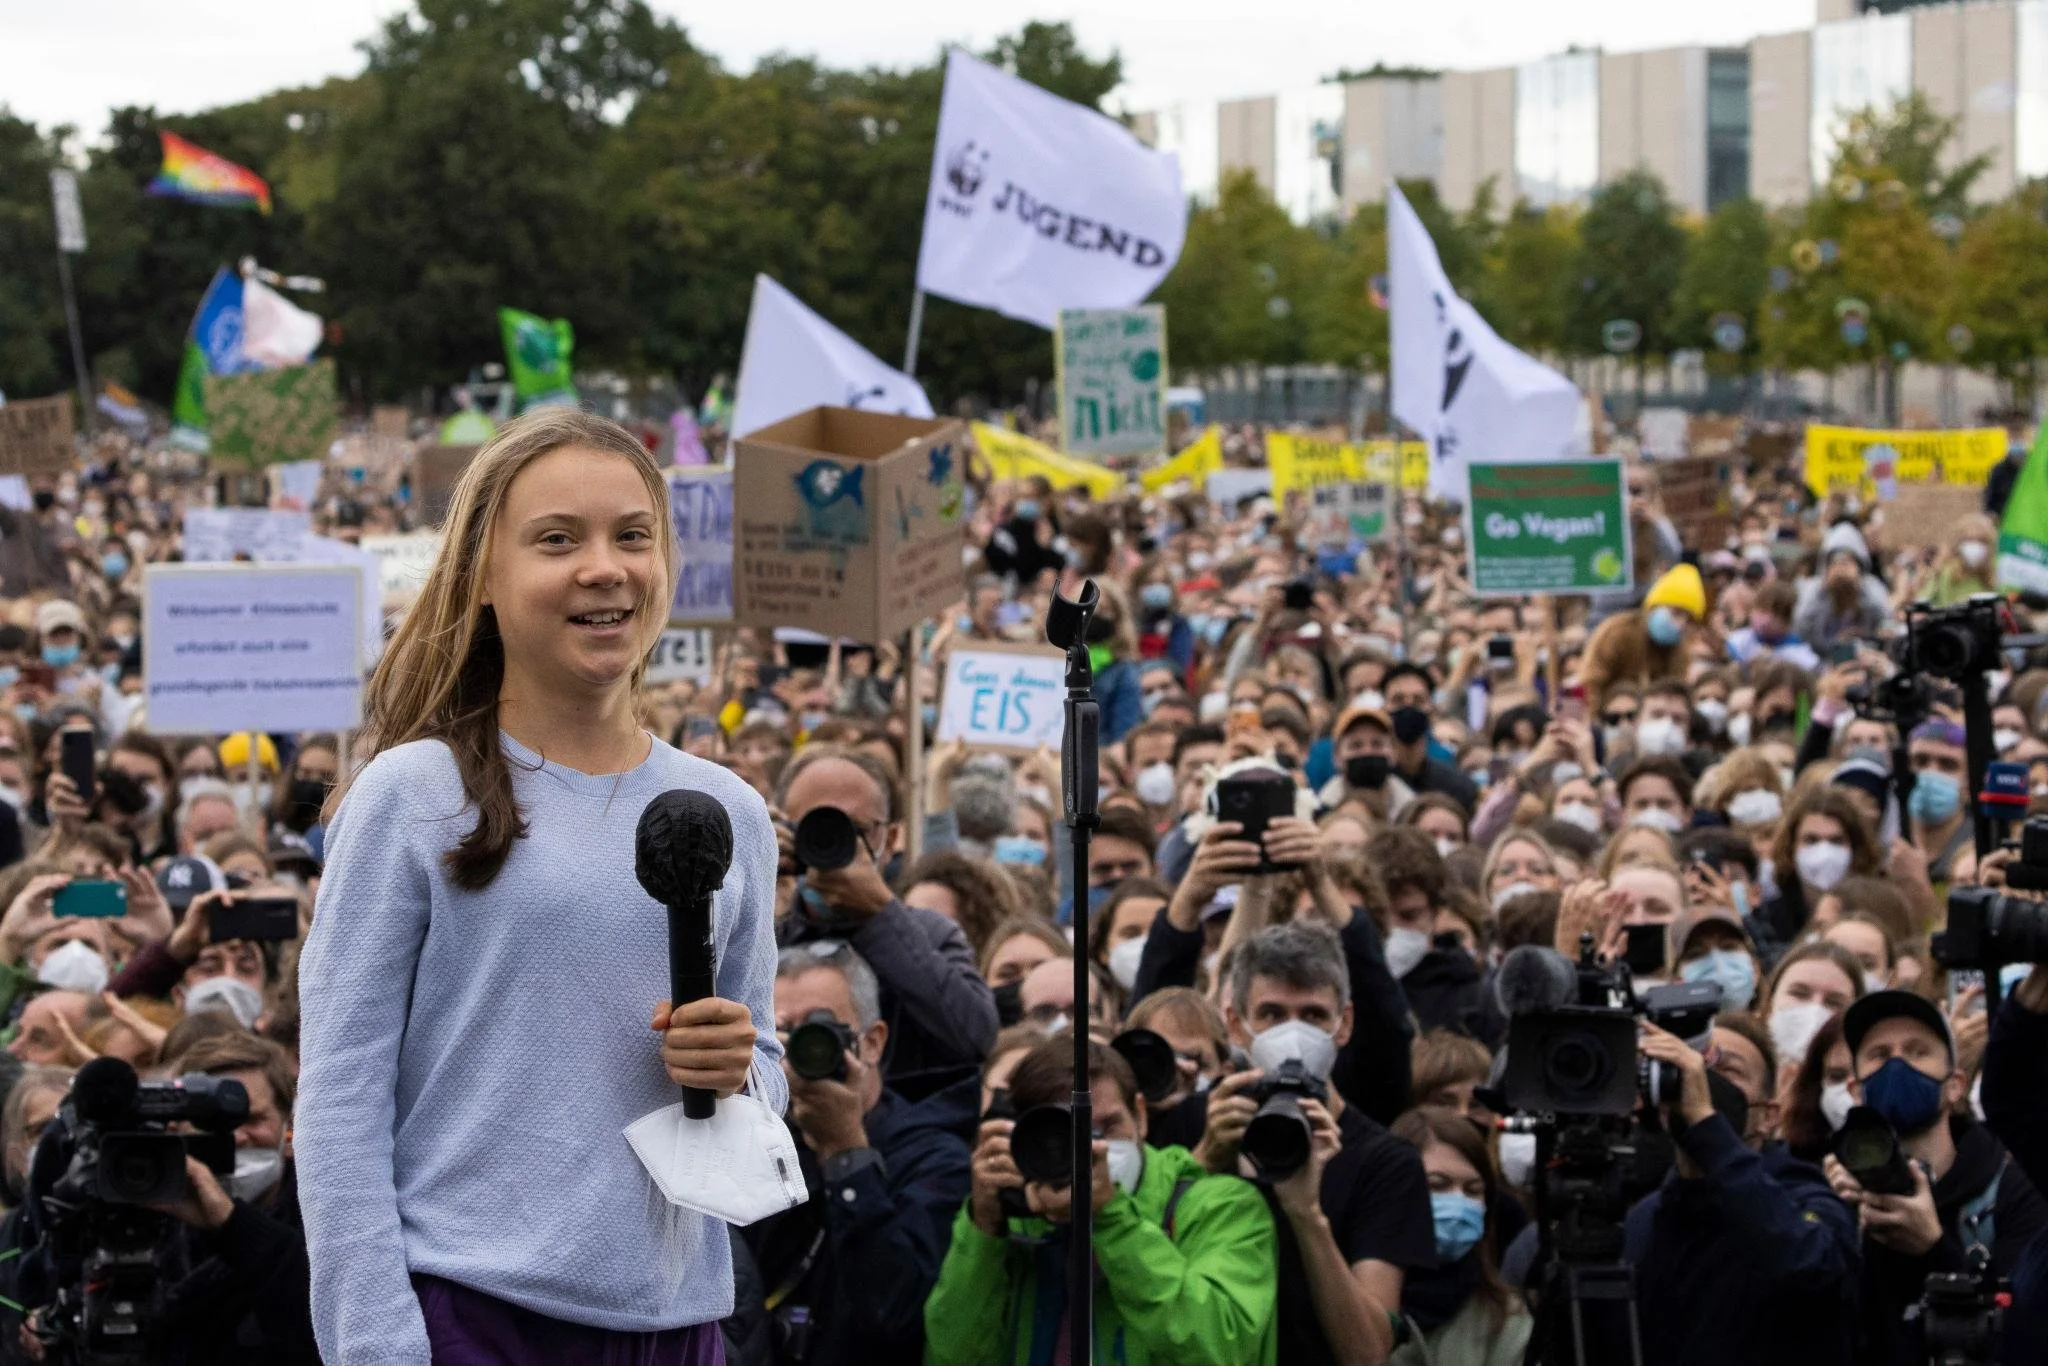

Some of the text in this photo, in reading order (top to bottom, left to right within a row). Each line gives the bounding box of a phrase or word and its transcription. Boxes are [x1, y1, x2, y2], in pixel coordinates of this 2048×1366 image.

[992, 180, 1166, 267] JUGEND
[1485, 511, 1605, 543] Go Vegan!
[652, 628, 704, 666] re!
[970, 687, 1031, 734] EIS
